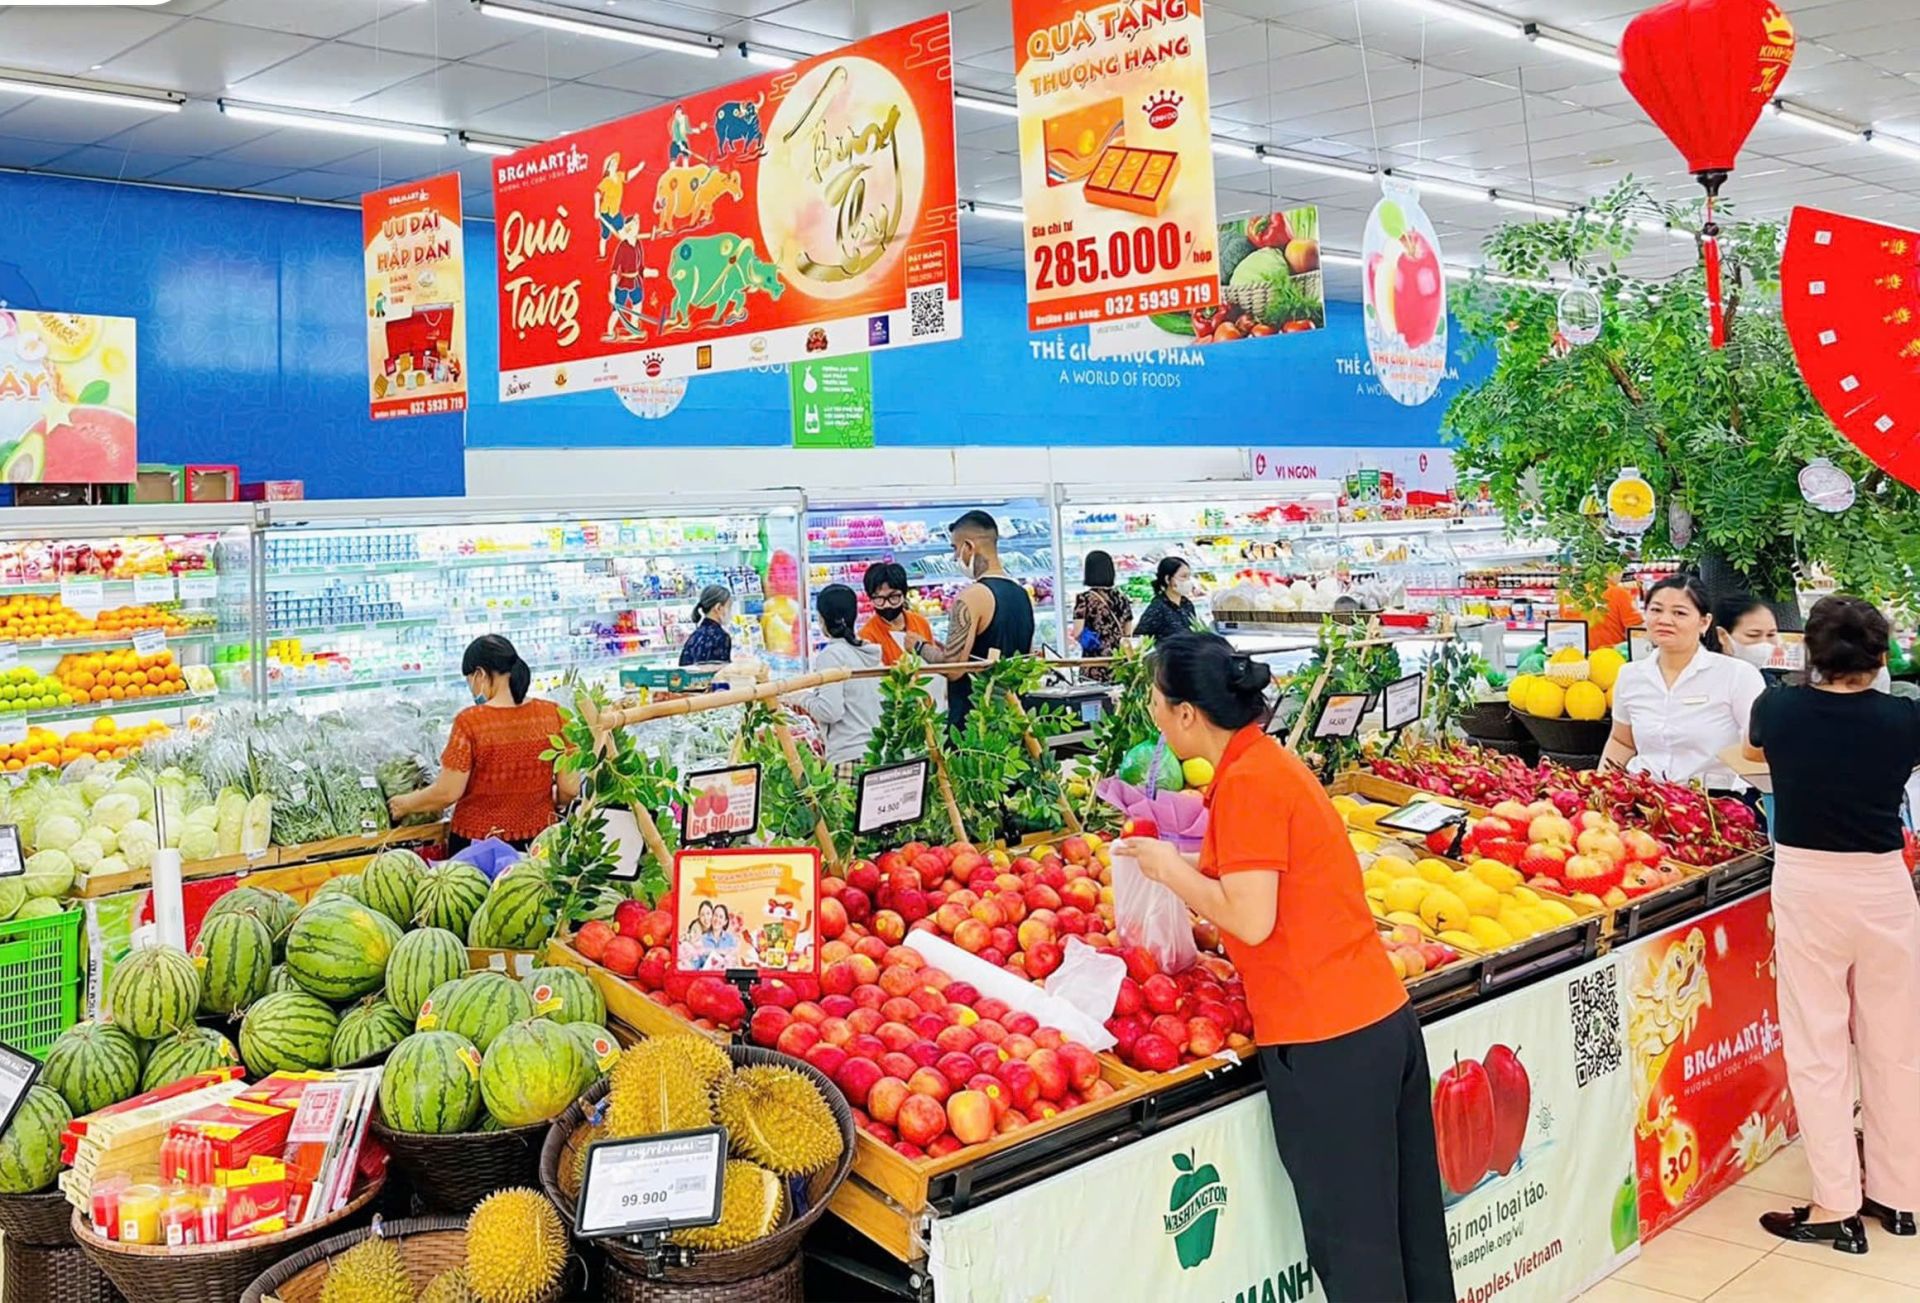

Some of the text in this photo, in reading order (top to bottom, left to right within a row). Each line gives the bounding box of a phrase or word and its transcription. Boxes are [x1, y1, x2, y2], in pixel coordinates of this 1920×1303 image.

[1028, 12, 1094, 59] QUÀ
[1124, 36, 1190, 70] HẠNG
[498, 152, 566, 184] BRGMART
[503, 205, 572, 272] Quà
[1034, 222, 1181, 291] 285.000
[504, 276, 581, 348] Tặng
[1105, 295, 1134, 316] 032
[1138, 288, 1179, 311] 5939
[1184, 283, 1211, 305] 719
[1059, 370, 1181, 388] A WORLD OF FOODS
[1288, 465, 1317, 479] NGON
[1684, 1021, 1759, 1081] BRGMART
[621, 1190, 667, 1207] 99.900
[1162, 1186, 1228, 1231] WASHINGTON
[1466, 1206, 1492, 1238] mọi
[1496, 1190, 1522, 1221] loại
[1524, 1181, 1548, 1208] táo.
